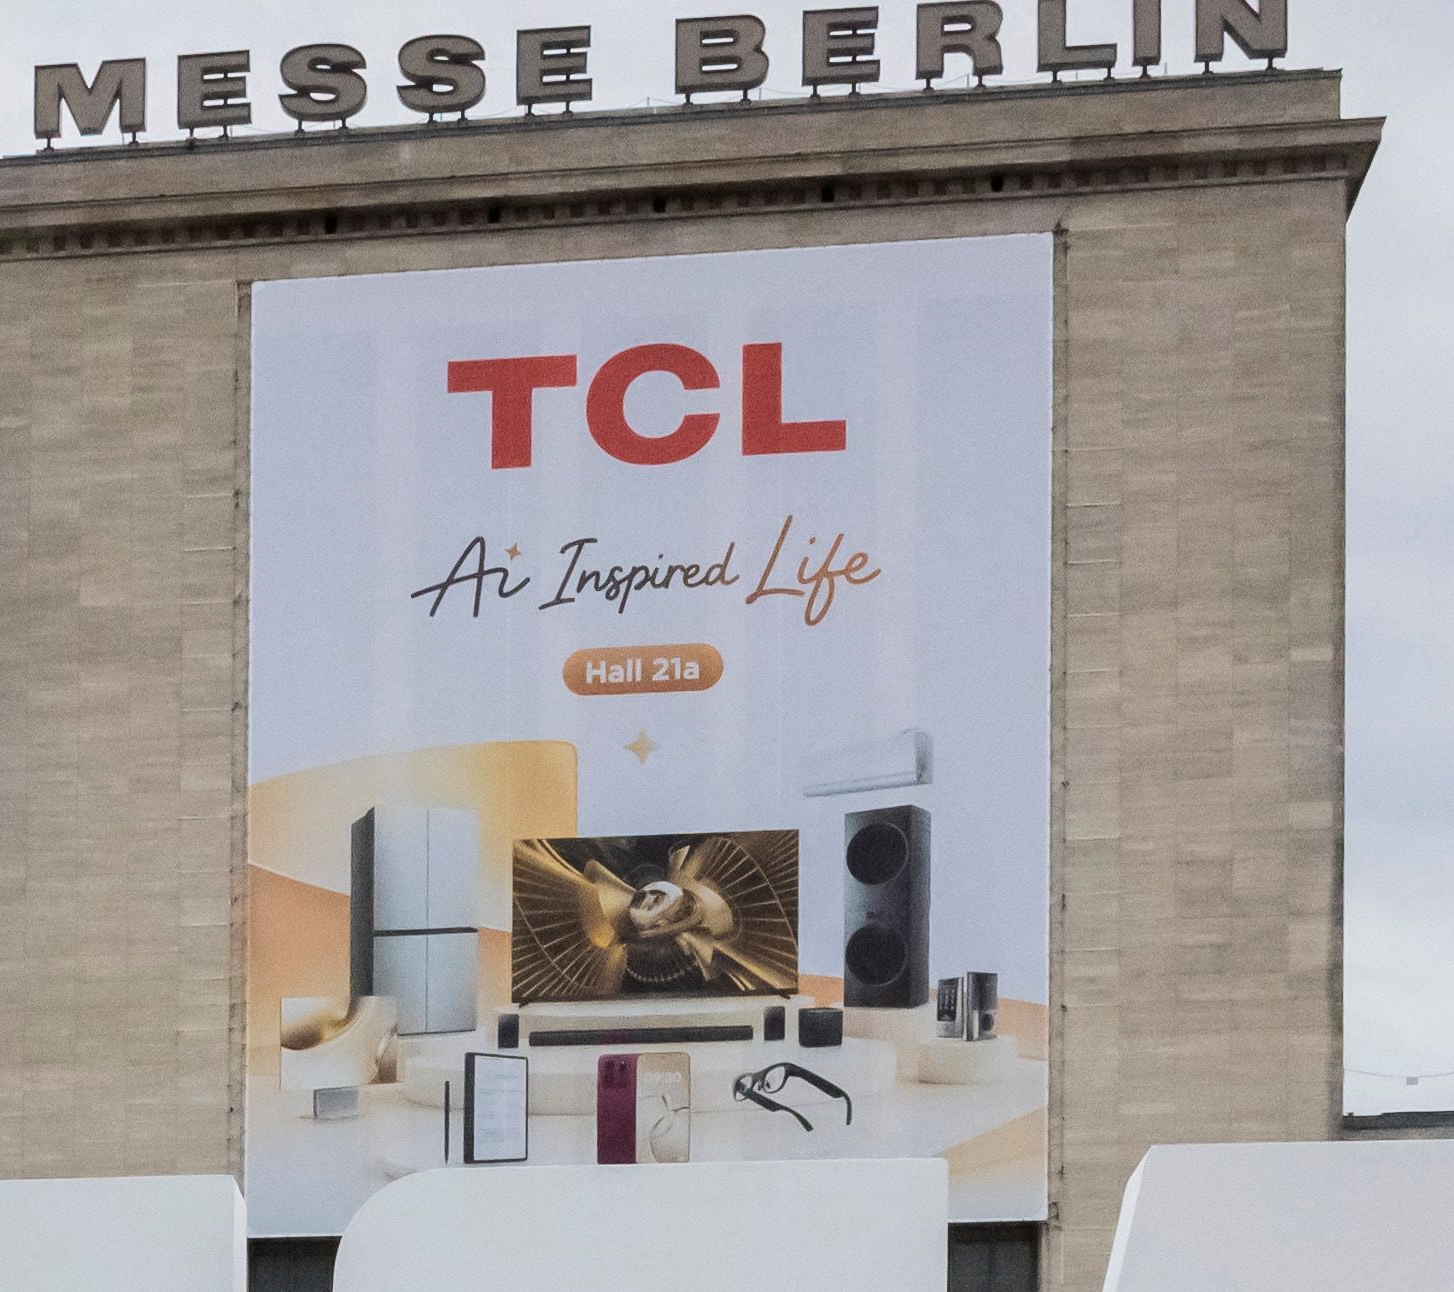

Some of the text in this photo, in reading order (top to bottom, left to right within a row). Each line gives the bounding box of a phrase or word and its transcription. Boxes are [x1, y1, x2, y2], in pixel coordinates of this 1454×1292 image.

[33, 0, 1288, 140] MESSE BERLIN
[447, 342, 846, 469] TCL
[411, 515, 882, 626] Ai Inspired Life
[585, 656, 700, 685] Hall 21a
